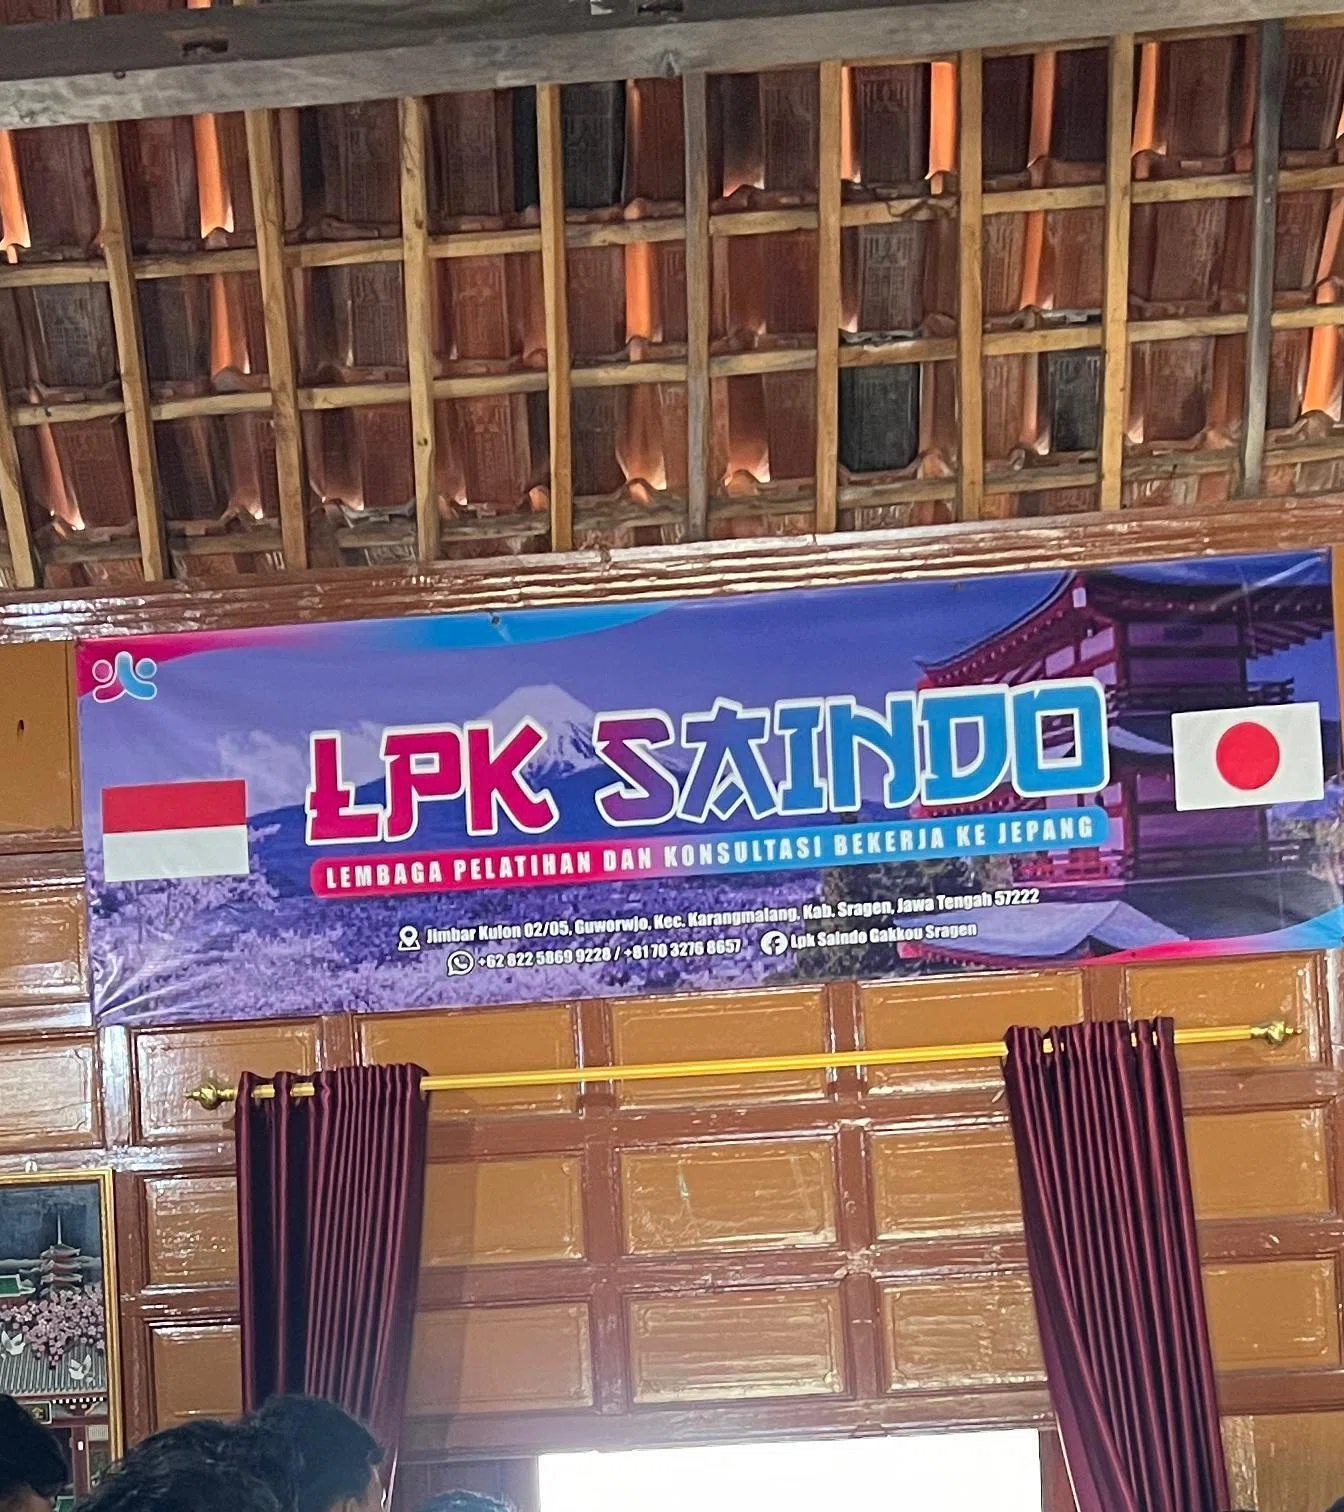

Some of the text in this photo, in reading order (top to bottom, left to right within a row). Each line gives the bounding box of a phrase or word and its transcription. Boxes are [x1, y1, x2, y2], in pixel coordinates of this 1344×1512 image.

[306, 677, 1111, 846] LPK SAINDO
[326, 815, 1093, 889] LEMBAGA PELATIHAN DAN KONSULTASI BEKERJA KE JEPANG
[426, 927, 477, 944] Jimbar
[478, 924, 522, 940] Kulon
[523, 920, 573, 938] 02/05,
[653, 914, 686, 930] Kec.
[802, 903, 835, 920] Kab.
[837, 900, 895, 918] Sragen,
[896, 897, 935, 914] Jawa
[936, 891, 993, 910] Tengah
[994, 887, 1040, 906] 57222
[790, 923, 978, 949] Lpk Saindo Gakkou Sragen
[477, 953, 505, 968] +62
[506, 951, 534, 967] 822
[535, 948, 573, 965] 5869
[575, 946, 612, 963] 9228
[669, 941, 705, 957] 3276
[706, 938, 741, 955] 8657
